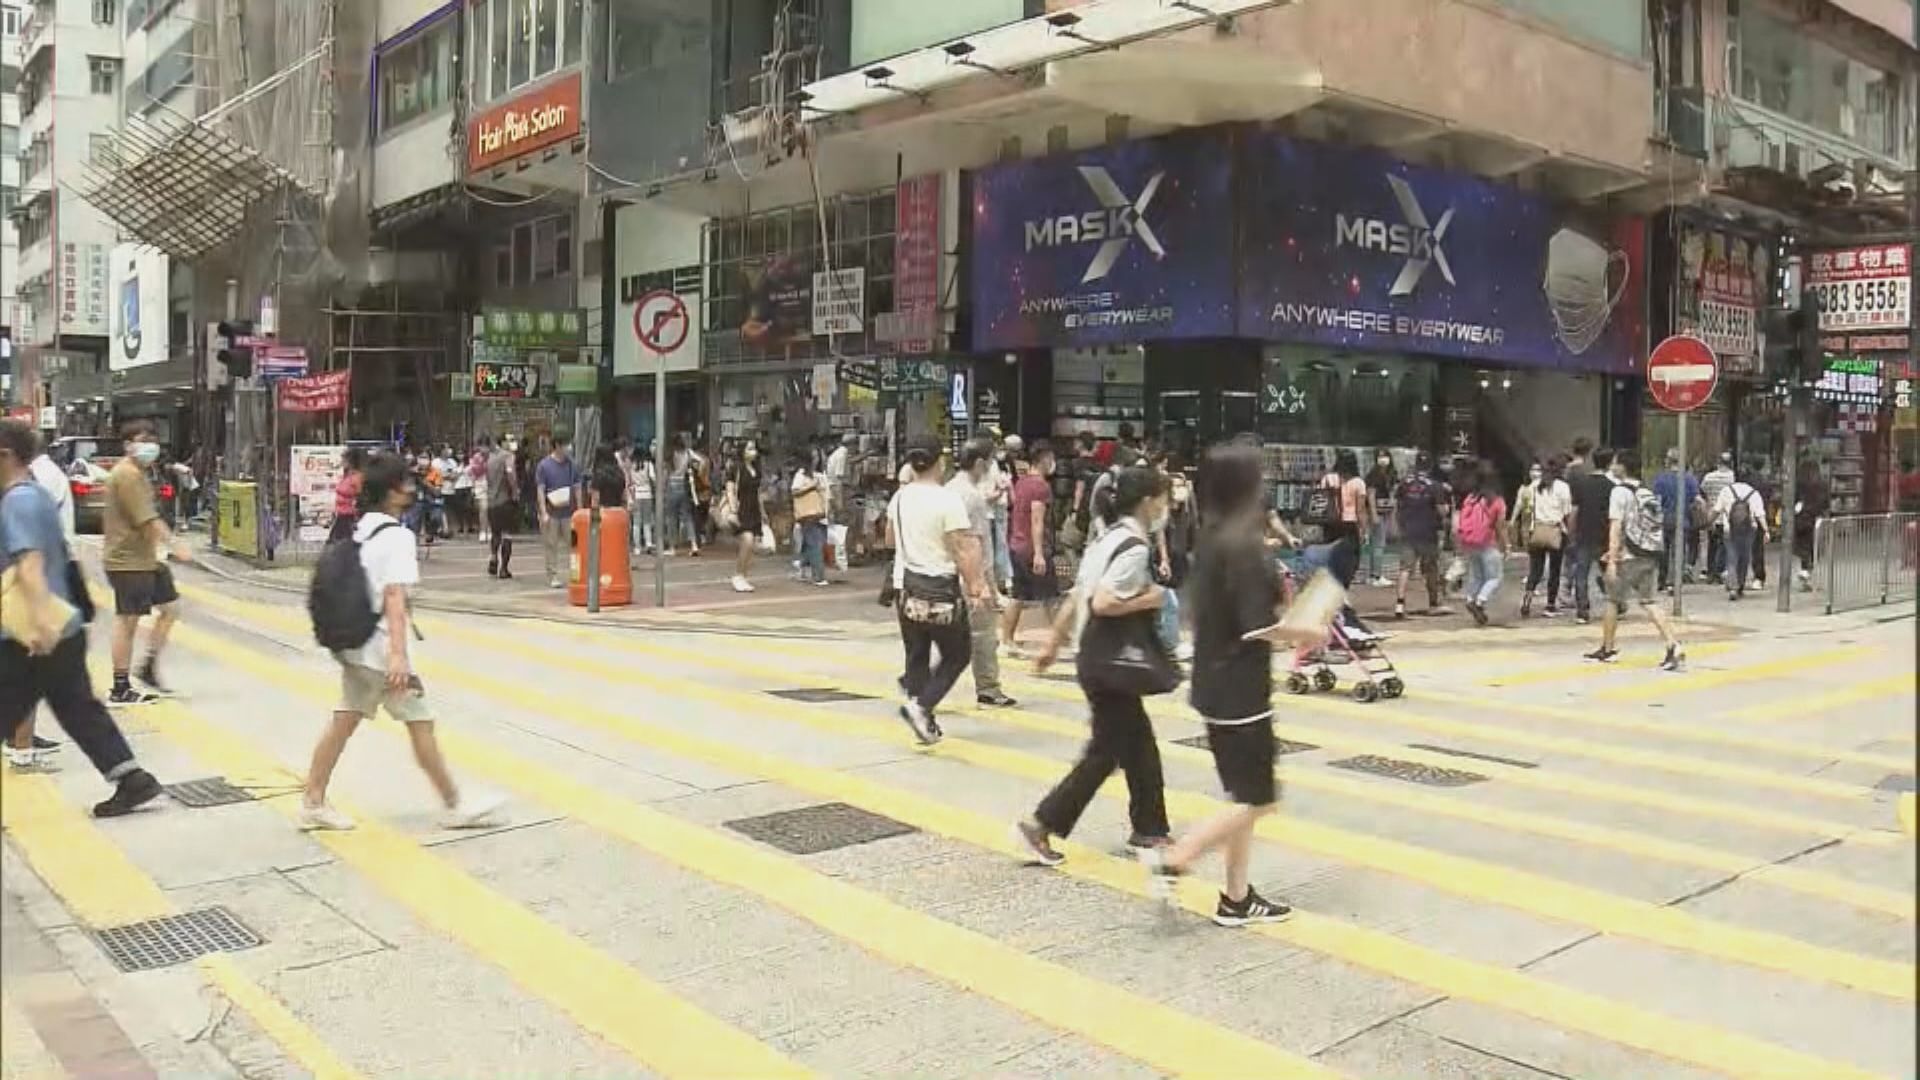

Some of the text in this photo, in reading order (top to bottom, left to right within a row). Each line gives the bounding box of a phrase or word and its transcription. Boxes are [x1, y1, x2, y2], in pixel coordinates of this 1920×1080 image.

[479, 122, 503, 155] Hair
[531, 104, 566, 135] Salon
[1019, 292, 1113, 315] ANYWHERE
[1854, 280, 1897, 311] 9558
[1065, 306, 1173, 328] EVERYWEAR
[1271, 302, 1504, 344] ANYWHERE EVERYWEAR
